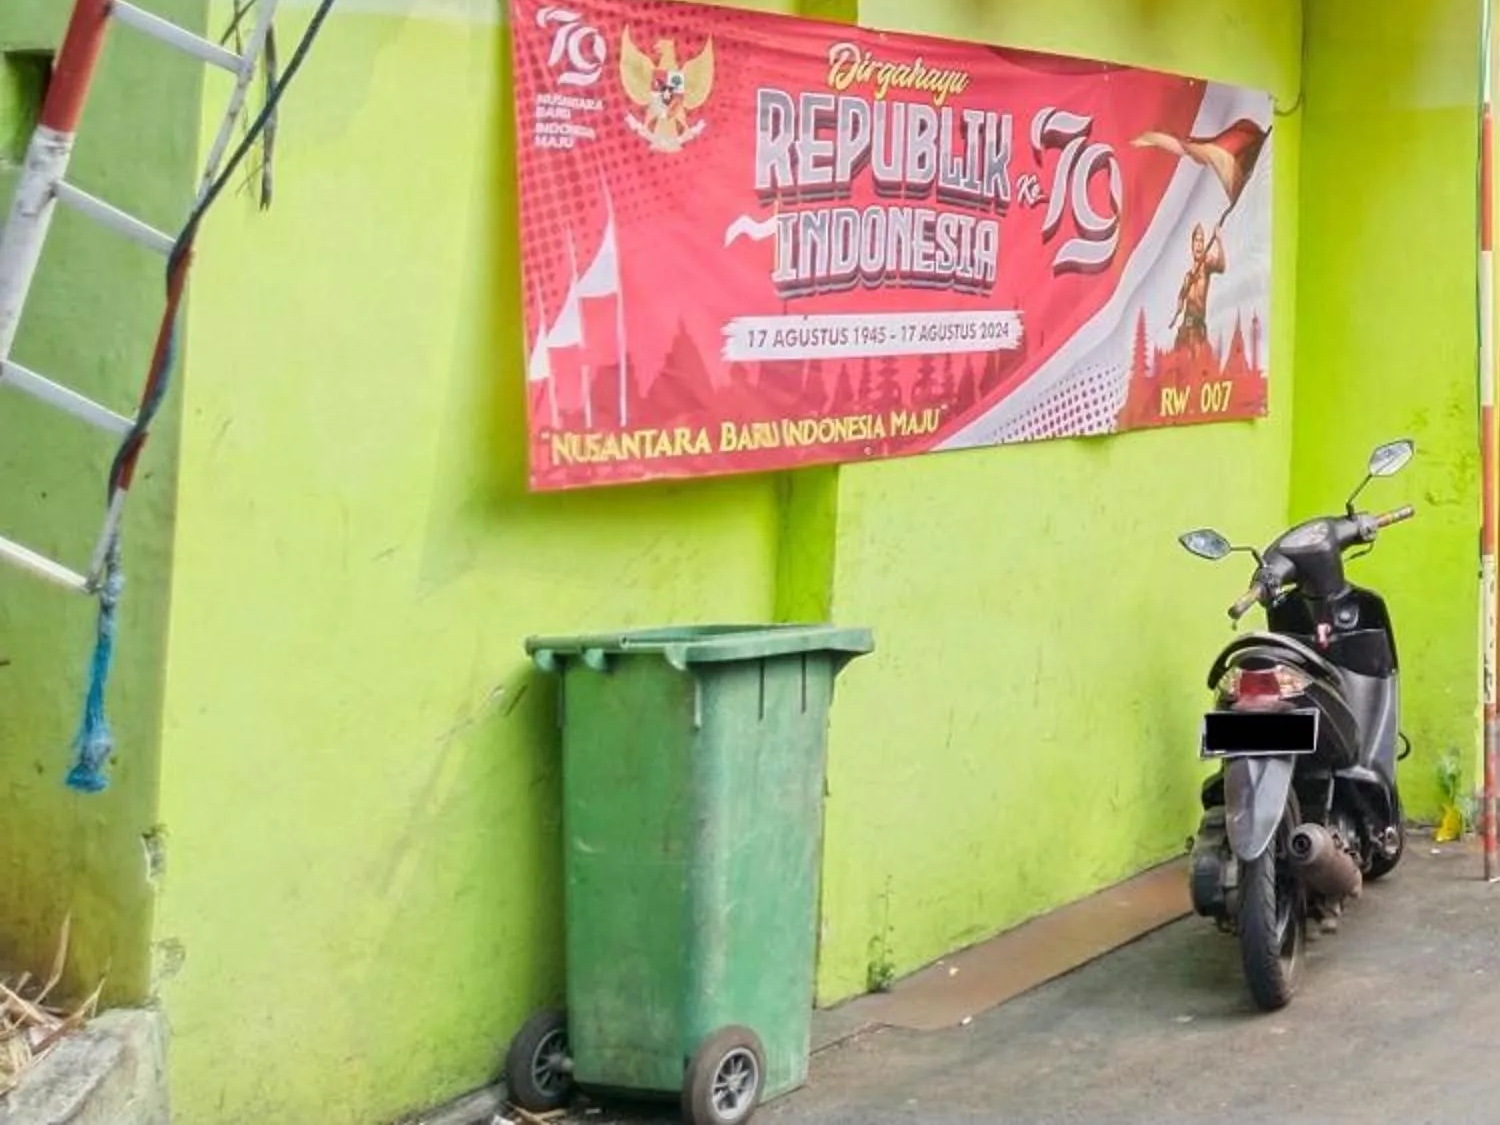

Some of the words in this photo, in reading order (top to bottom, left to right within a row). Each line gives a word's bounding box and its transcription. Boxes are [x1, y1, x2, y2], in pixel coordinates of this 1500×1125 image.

[536, 6, 606, 87] 79
[827, 41, 970, 107] Dirgahayu
[754, 87, 1014, 209] REPUBLIK
[1029, 105, 1123, 276] 79
[772, 205, 1001, 295] INDONESIA
[748, 329, 768, 348] 17
[773, 326, 849, 348] AGUSTUS
[853, 325, 887, 345] 1945
[901, 324, 917, 342] 17
[918, 321, 978, 342] AGUSTUS
[980, 321, 1010, 340] 2024
[781, 414, 886, 447] INDONESIA
[1201, 380, 1233, 413] 007
